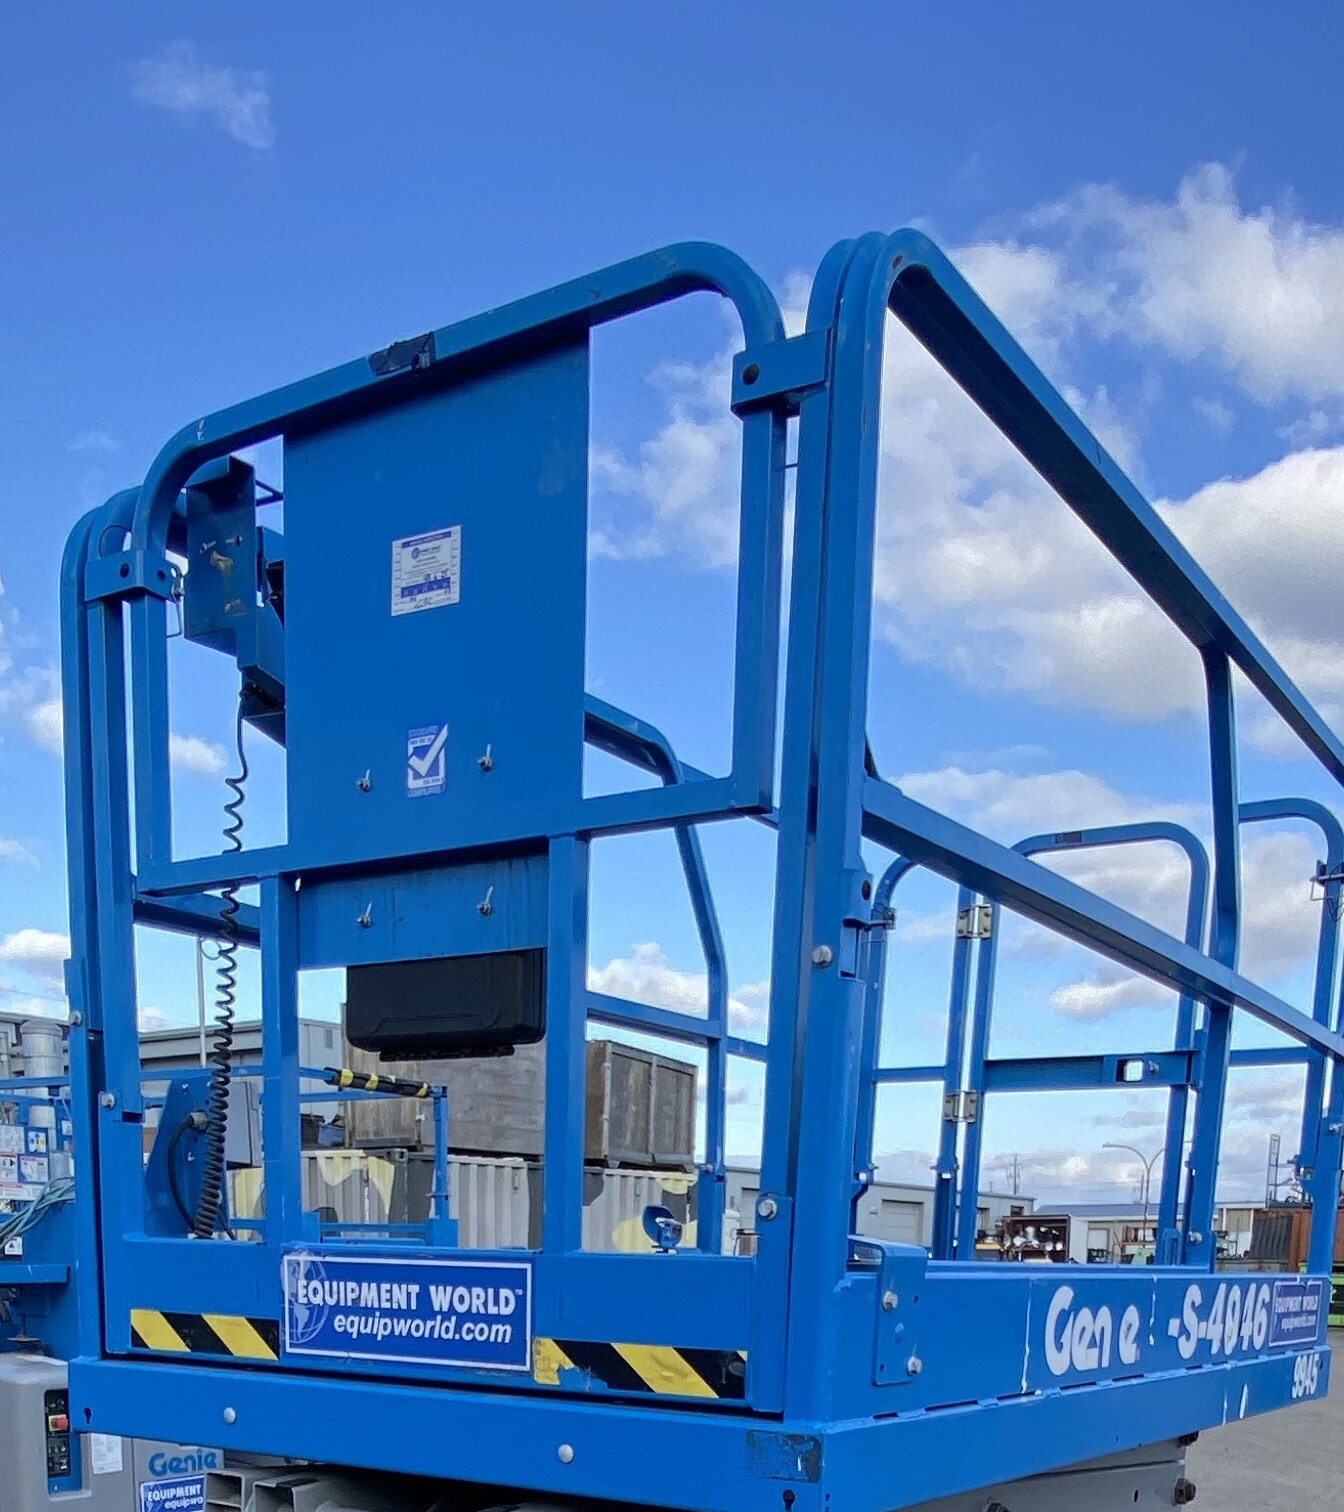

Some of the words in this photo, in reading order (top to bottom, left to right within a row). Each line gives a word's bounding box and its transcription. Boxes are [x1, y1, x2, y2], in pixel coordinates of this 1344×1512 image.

[297, 1279, 420, 1311] EQUIPMENT
[429, 1285, 517, 1316] WORLD
[333, 1312, 512, 1343] equipworld.com
[1045, 1284, 1140, 1376] Gene
[148, 1450, 218, 1477] Genie
[147, 1484, 201, 1502] EQUIPMENT
[164, 1495, 204, 1510] equipwo
